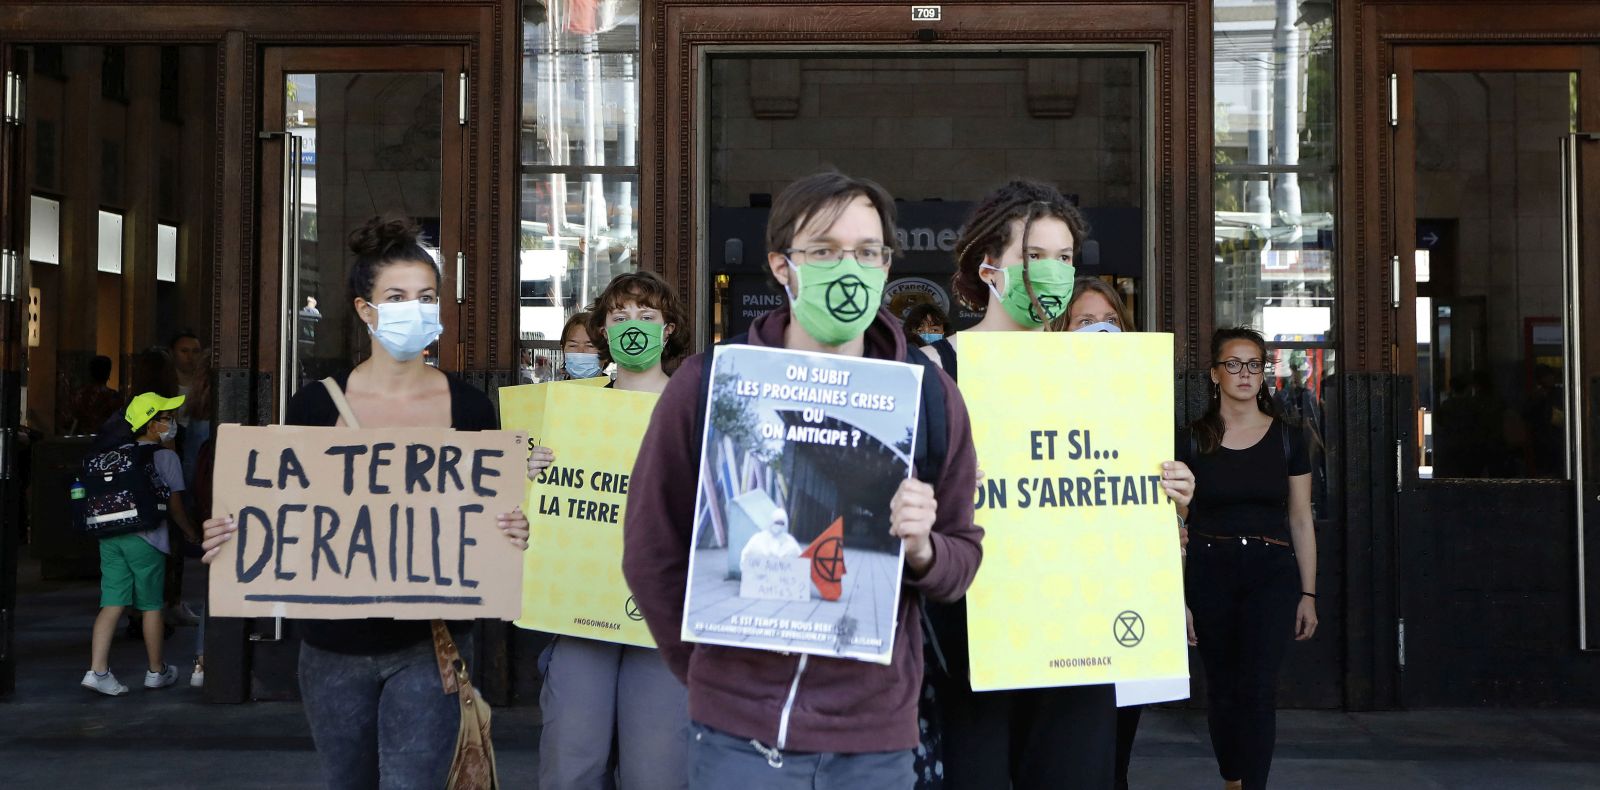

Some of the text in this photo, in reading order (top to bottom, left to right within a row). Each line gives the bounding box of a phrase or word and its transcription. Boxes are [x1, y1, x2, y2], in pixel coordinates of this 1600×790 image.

[917, 8, 935, 18] 709
[896, 226, 963, 251] ane
[742, 294, 783, 306] PAINS
[786, 364, 850, 386] ON SUBIT
[736, 380, 895, 412] LES PROCHAINES CRISES
[802, 407, 825, 424] OU
[762, 423, 862, 448] ON ANTICIPE ?
[1030, 429, 1119, 461] ET SI...
[245, 442, 504, 498] LA TERRE
[536, 465, 629, 495] SANS CRIE
[973, 468, 1172, 511] ON S'ARRÊTAIT
[538, 494, 620, 525] LA TERRE
[235, 501, 485, 589] DERAILLE
[573, 617, 622, 631] #NOGOINGBACK
[1049, 656, 1112, 668] #NOGOINGBACK
